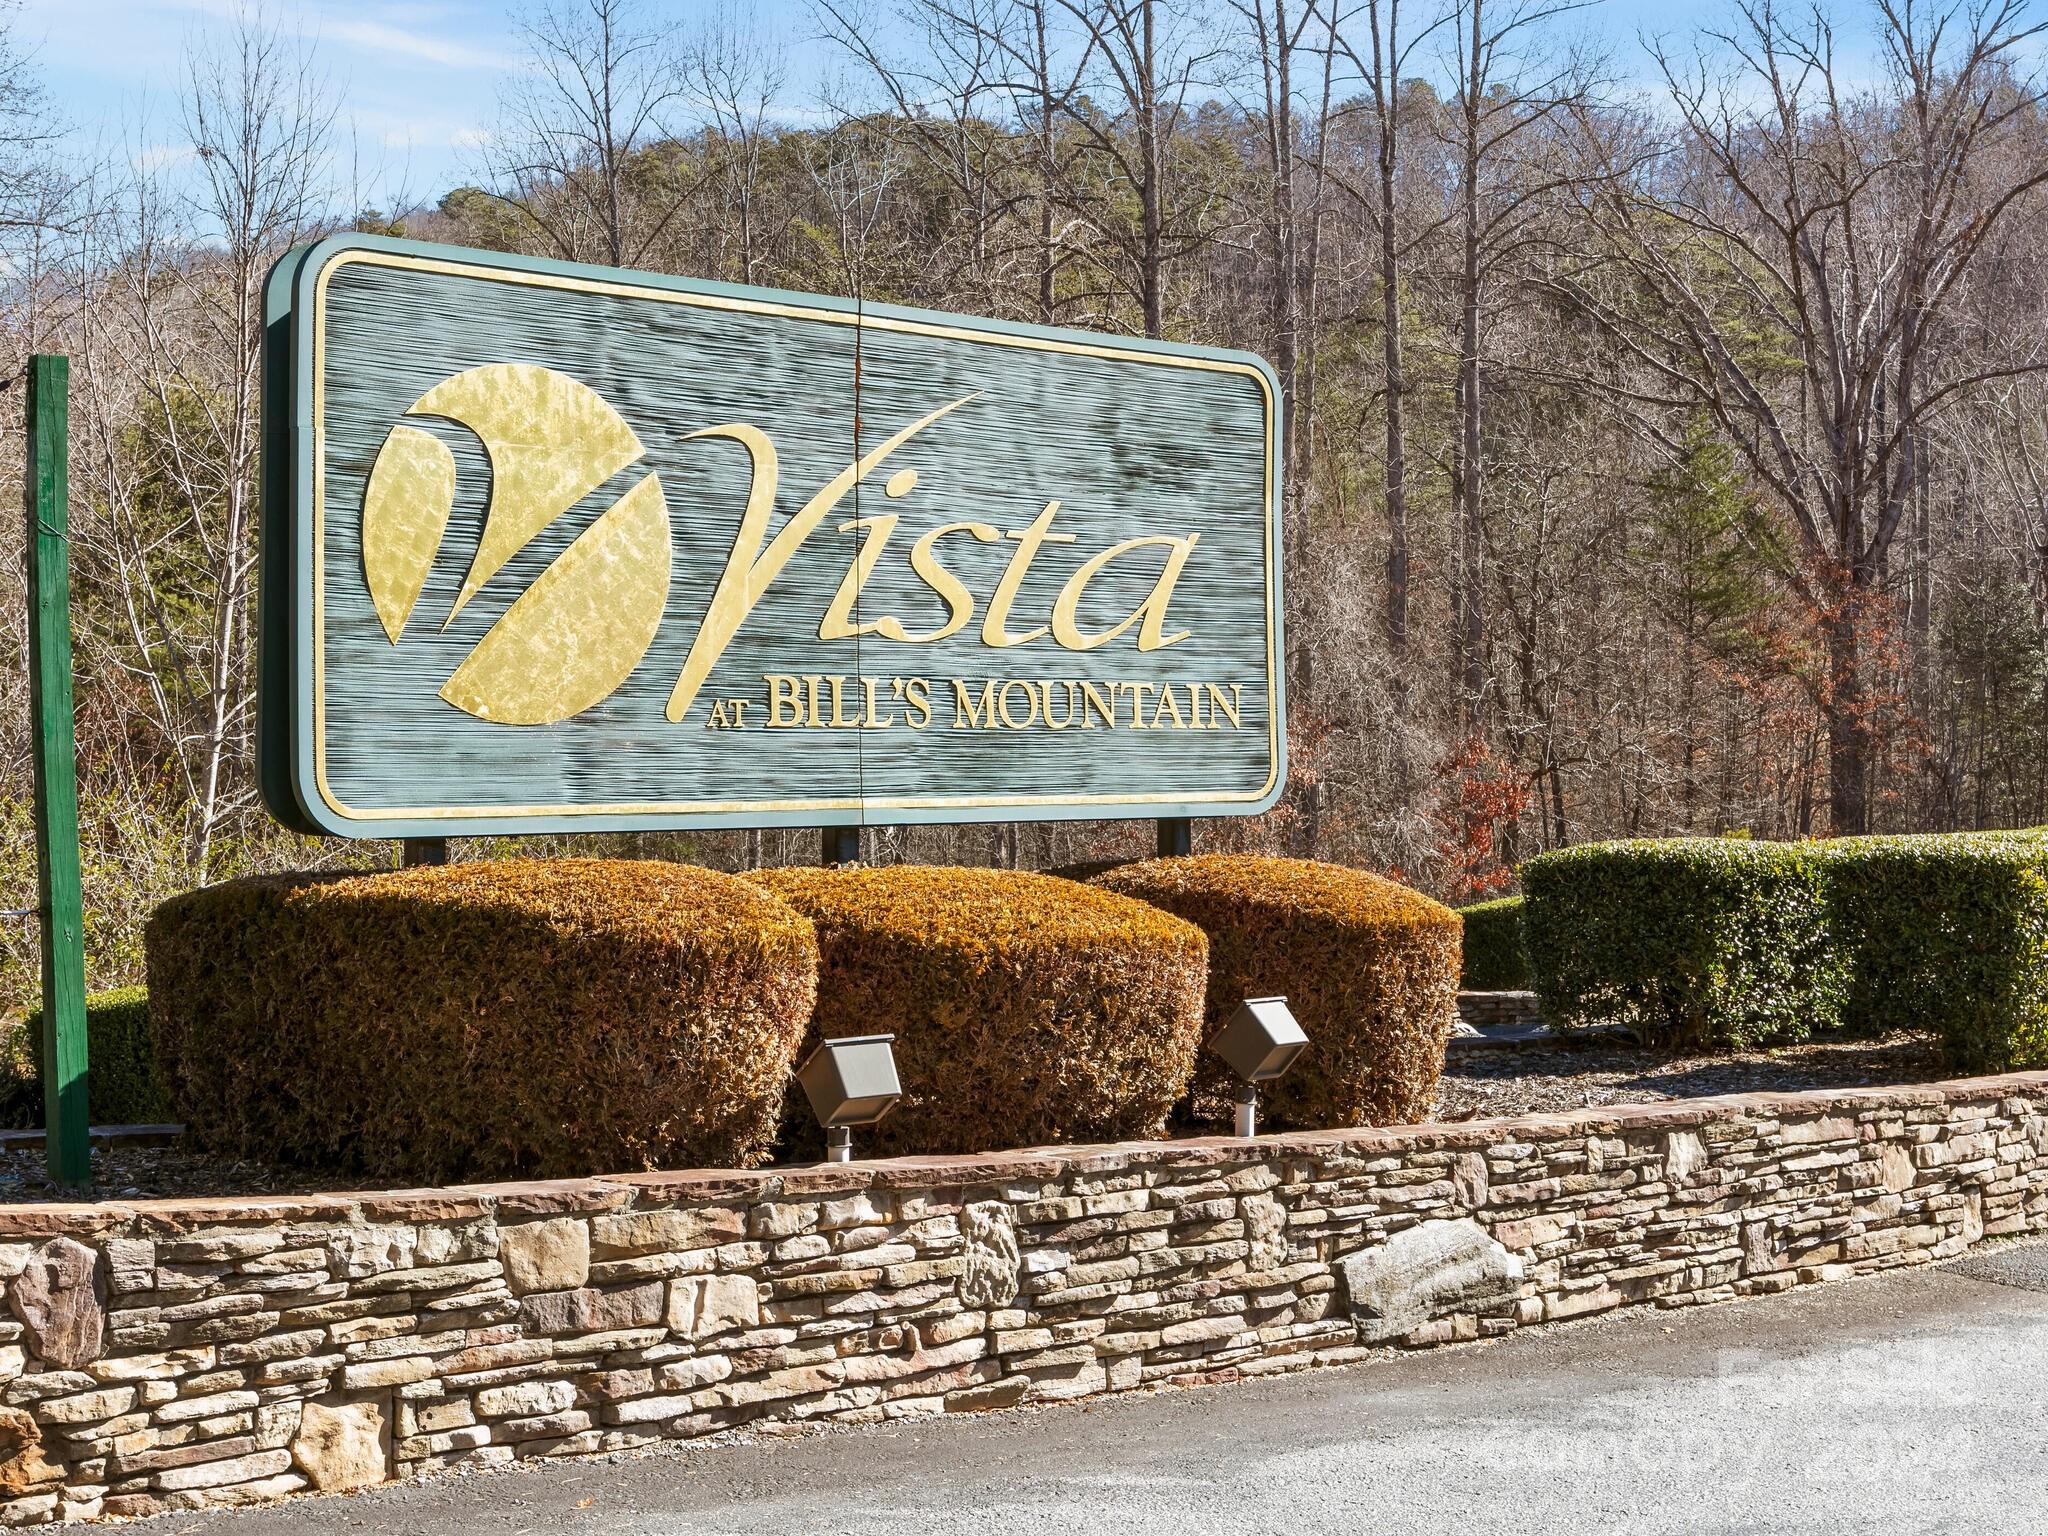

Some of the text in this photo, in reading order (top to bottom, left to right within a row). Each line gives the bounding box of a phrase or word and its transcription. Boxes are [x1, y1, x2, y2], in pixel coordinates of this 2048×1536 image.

[665, 390, 1201, 724] Vista
[706, 674, 1243, 731] AT BILL'S MOUNTAIN
